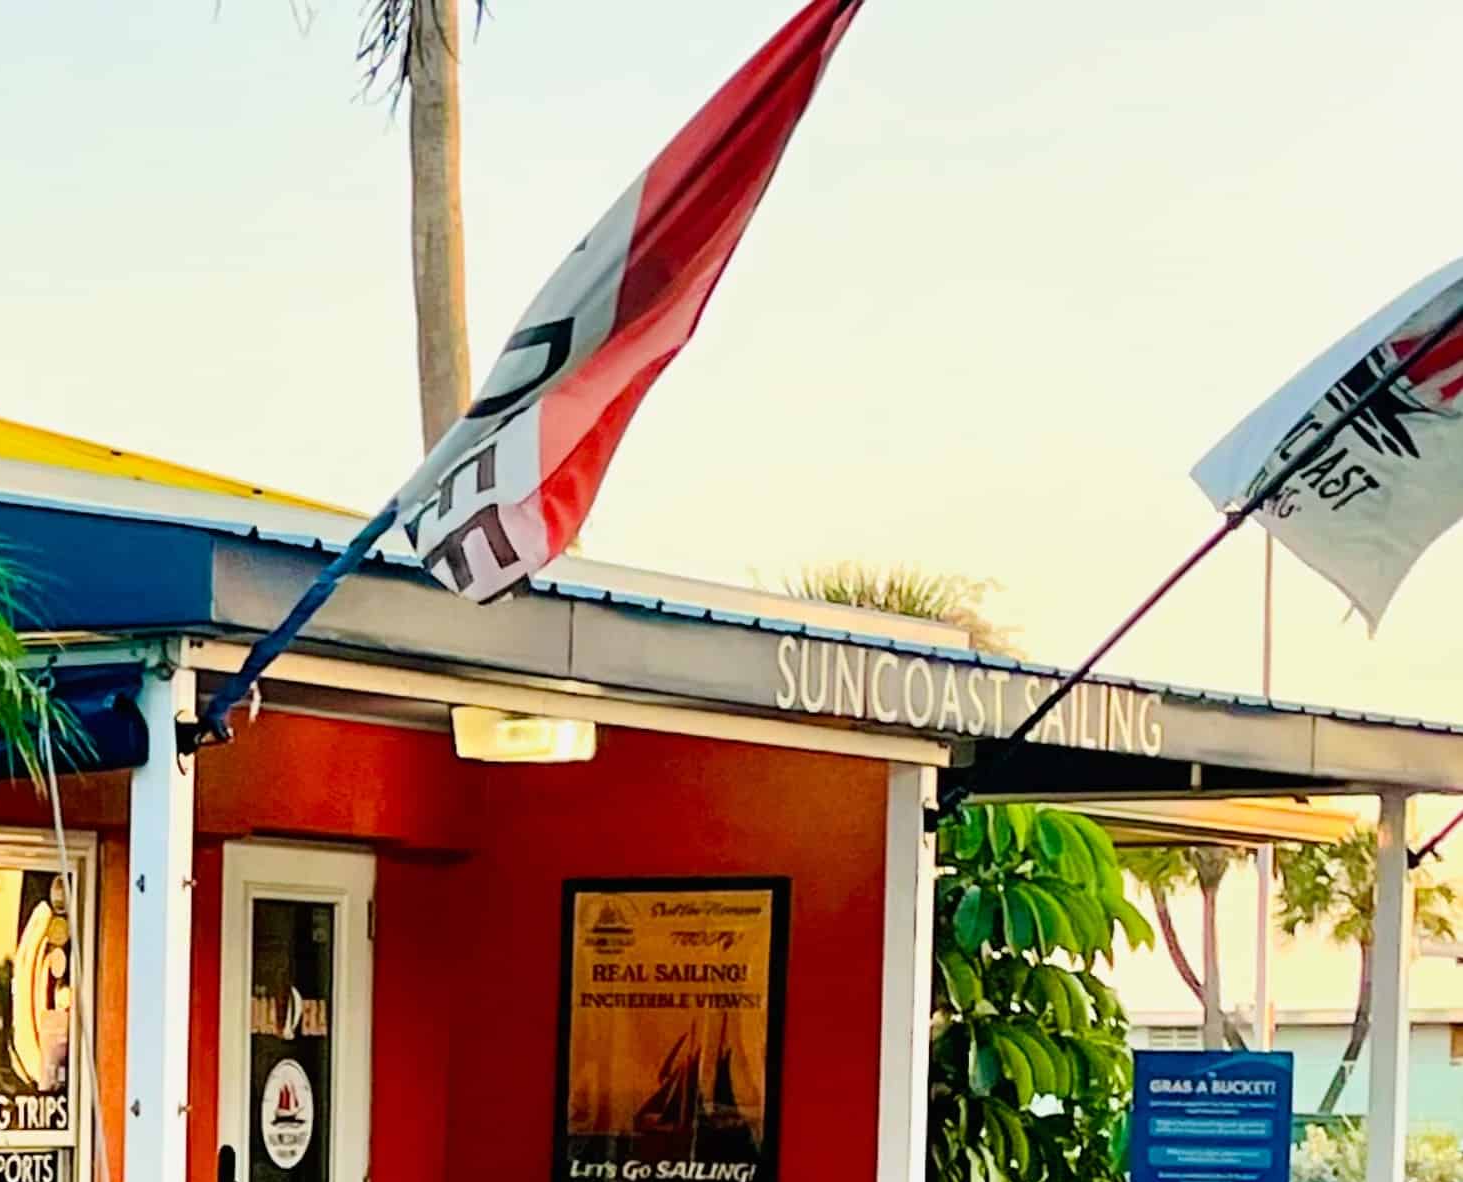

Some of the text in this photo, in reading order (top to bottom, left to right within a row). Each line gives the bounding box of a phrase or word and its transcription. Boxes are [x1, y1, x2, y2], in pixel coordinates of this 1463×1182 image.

[775, 635, 1163, 757] SUNCOAST SAILING
[592, 964, 748, 983] REAL SAILING!
[1196, 1079, 1208, 1095] A
[15, 1094, 68, 1130] TRIPS
